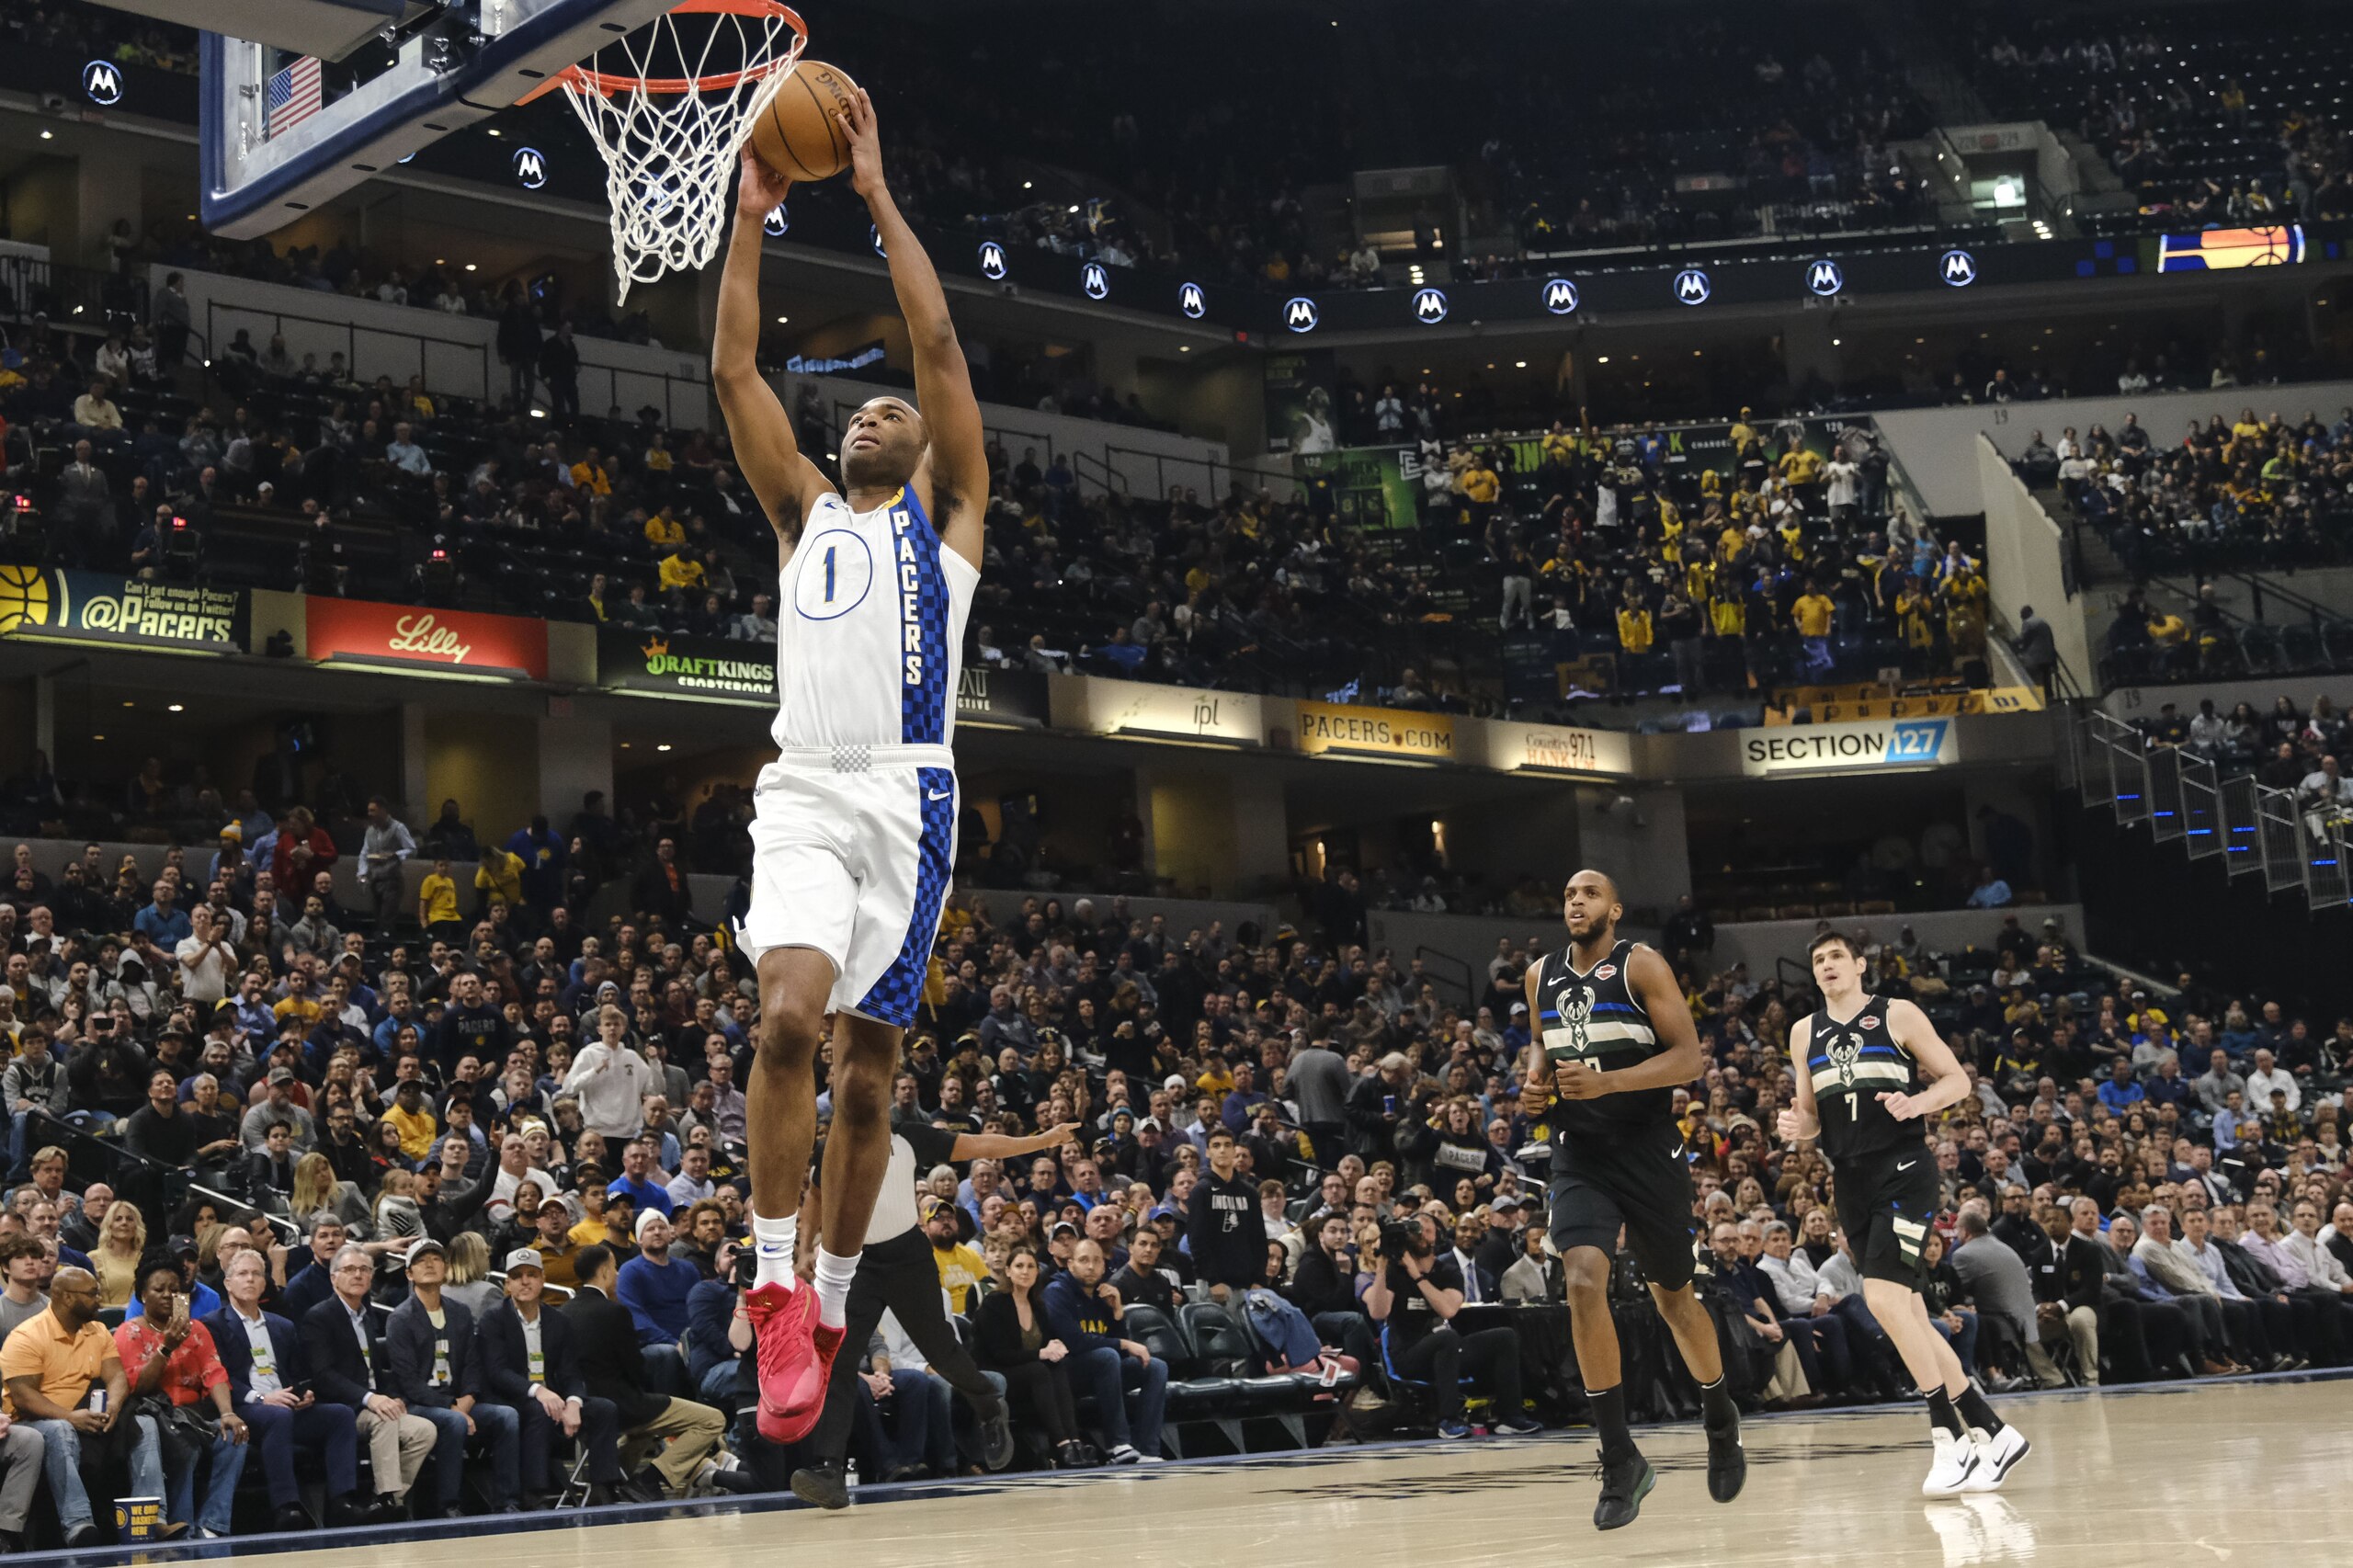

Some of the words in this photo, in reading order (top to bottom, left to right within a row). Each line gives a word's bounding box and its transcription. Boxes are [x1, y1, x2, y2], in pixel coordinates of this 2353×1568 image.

[823, 545, 837, 604] 1
[125, 580, 149, 596] Can't
[150, 584, 166, 598] get
[167, 585, 199, 601] enough
[201, 588, 239, 604] Pacers?
[143, 595, 173, 612] Follow
[174, 601, 186, 612] us
[187, 602, 199, 613] on
[892, 510, 923, 686] PACERS
[81, 596, 233, 642] @Pacers
[389, 614, 471, 664] Lilly
[646, 653, 774, 681] DRAFTKINGS
[1526, 734, 1568, 749] Country
[1569, 733, 1596, 759] 97.1
[1747, 732, 1883, 762] SECTION
[1891, 728, 1937, 755] 127
[458, 1018, 495, 1033] PACERS
[1844, 1092, 1857, 1121] 7
[1449, 1150, 1482, 1165] PACERS
[1211, 1194, 1248, 1210] INDIANA
[131, 1505, 142, 1515] WE
[131, 1526, 148, 1536] HERE
